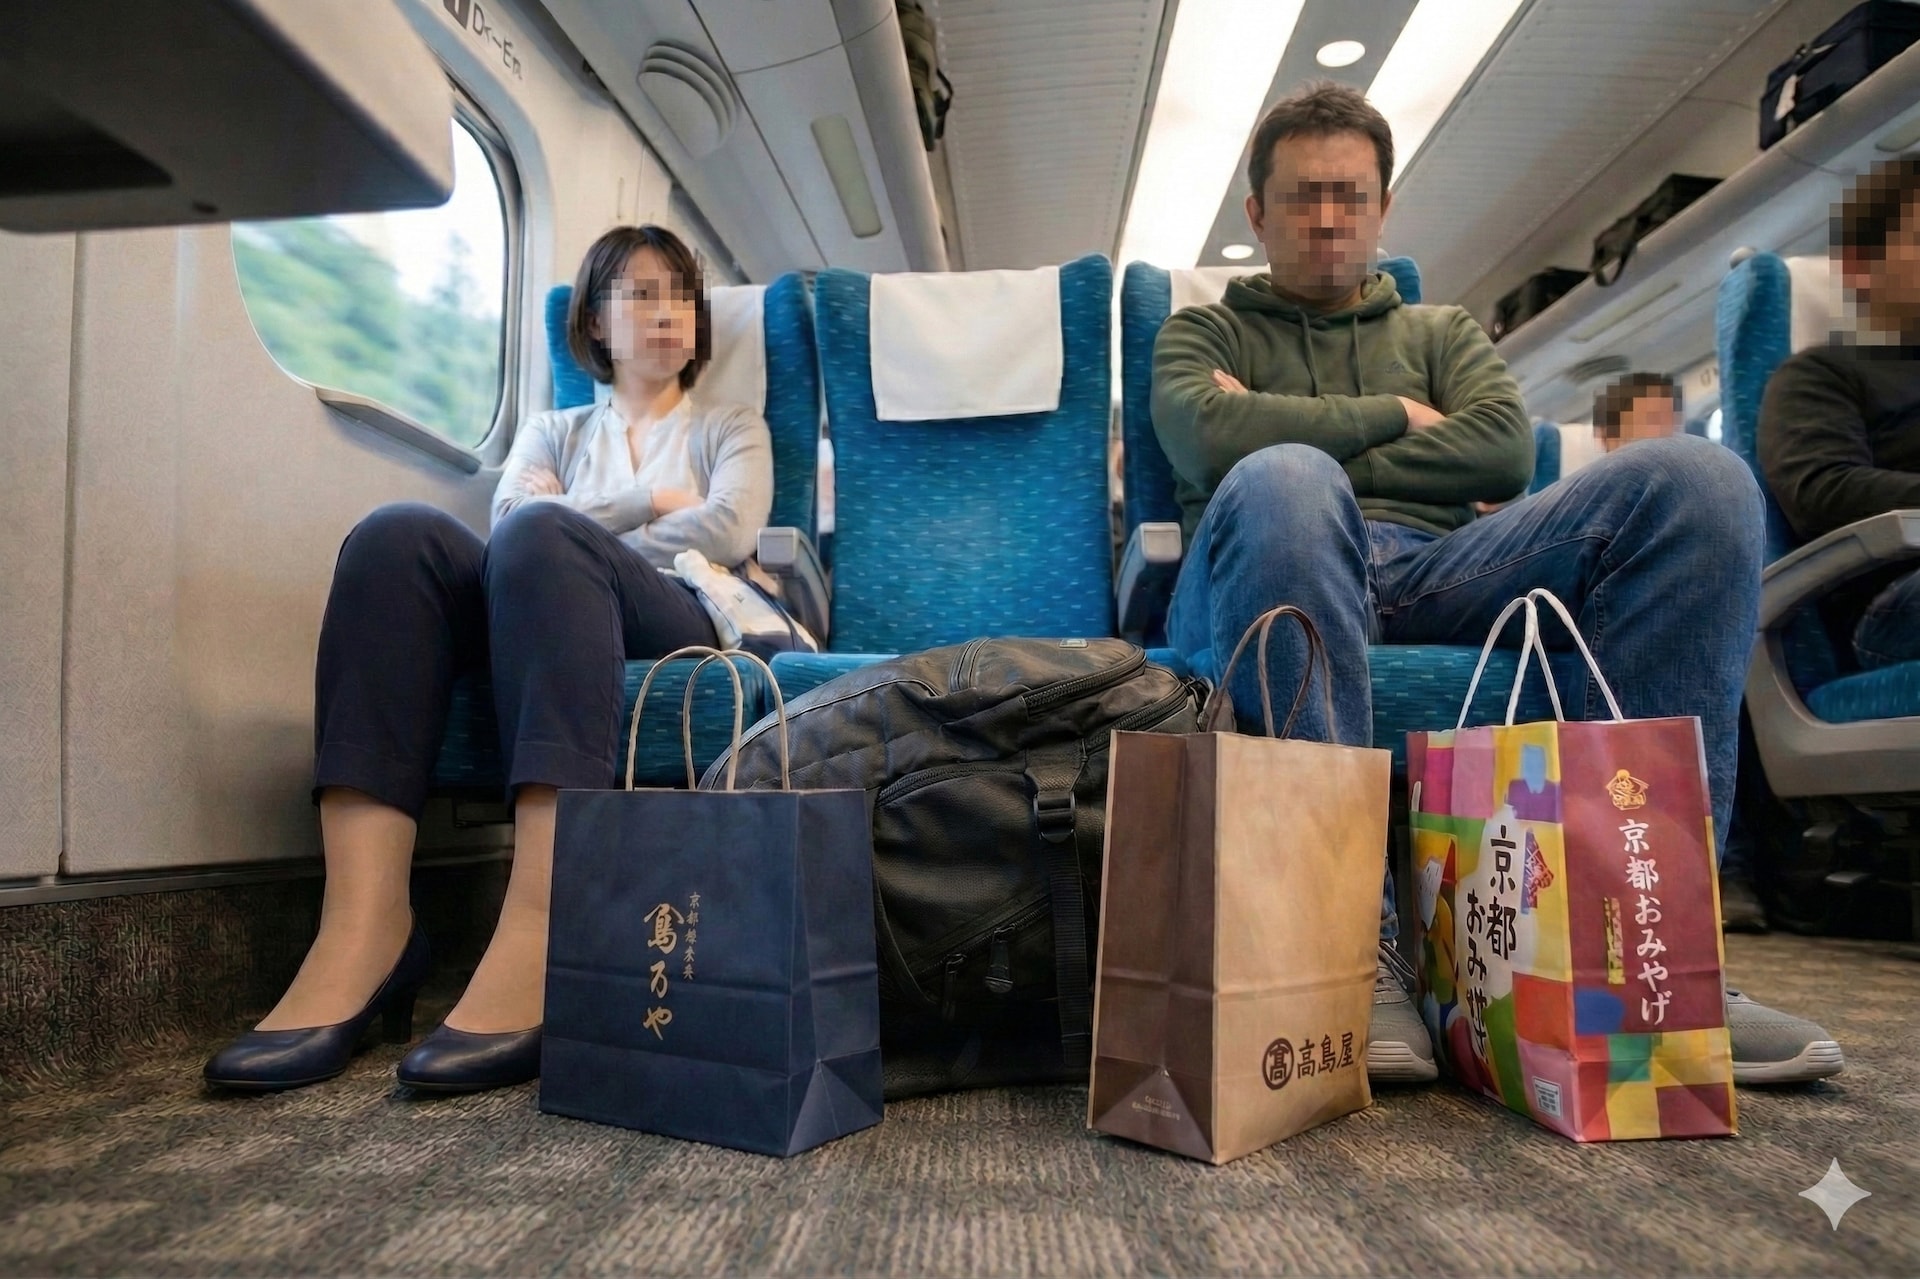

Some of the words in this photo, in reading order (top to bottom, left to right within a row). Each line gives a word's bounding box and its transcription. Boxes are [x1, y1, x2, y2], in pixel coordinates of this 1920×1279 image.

[1486, 824, 1518, 961] 京都
[1618, 818, 1673, 1026] 京都おみやげ
[1297, 1031, 1354, 1079] 高島屋
